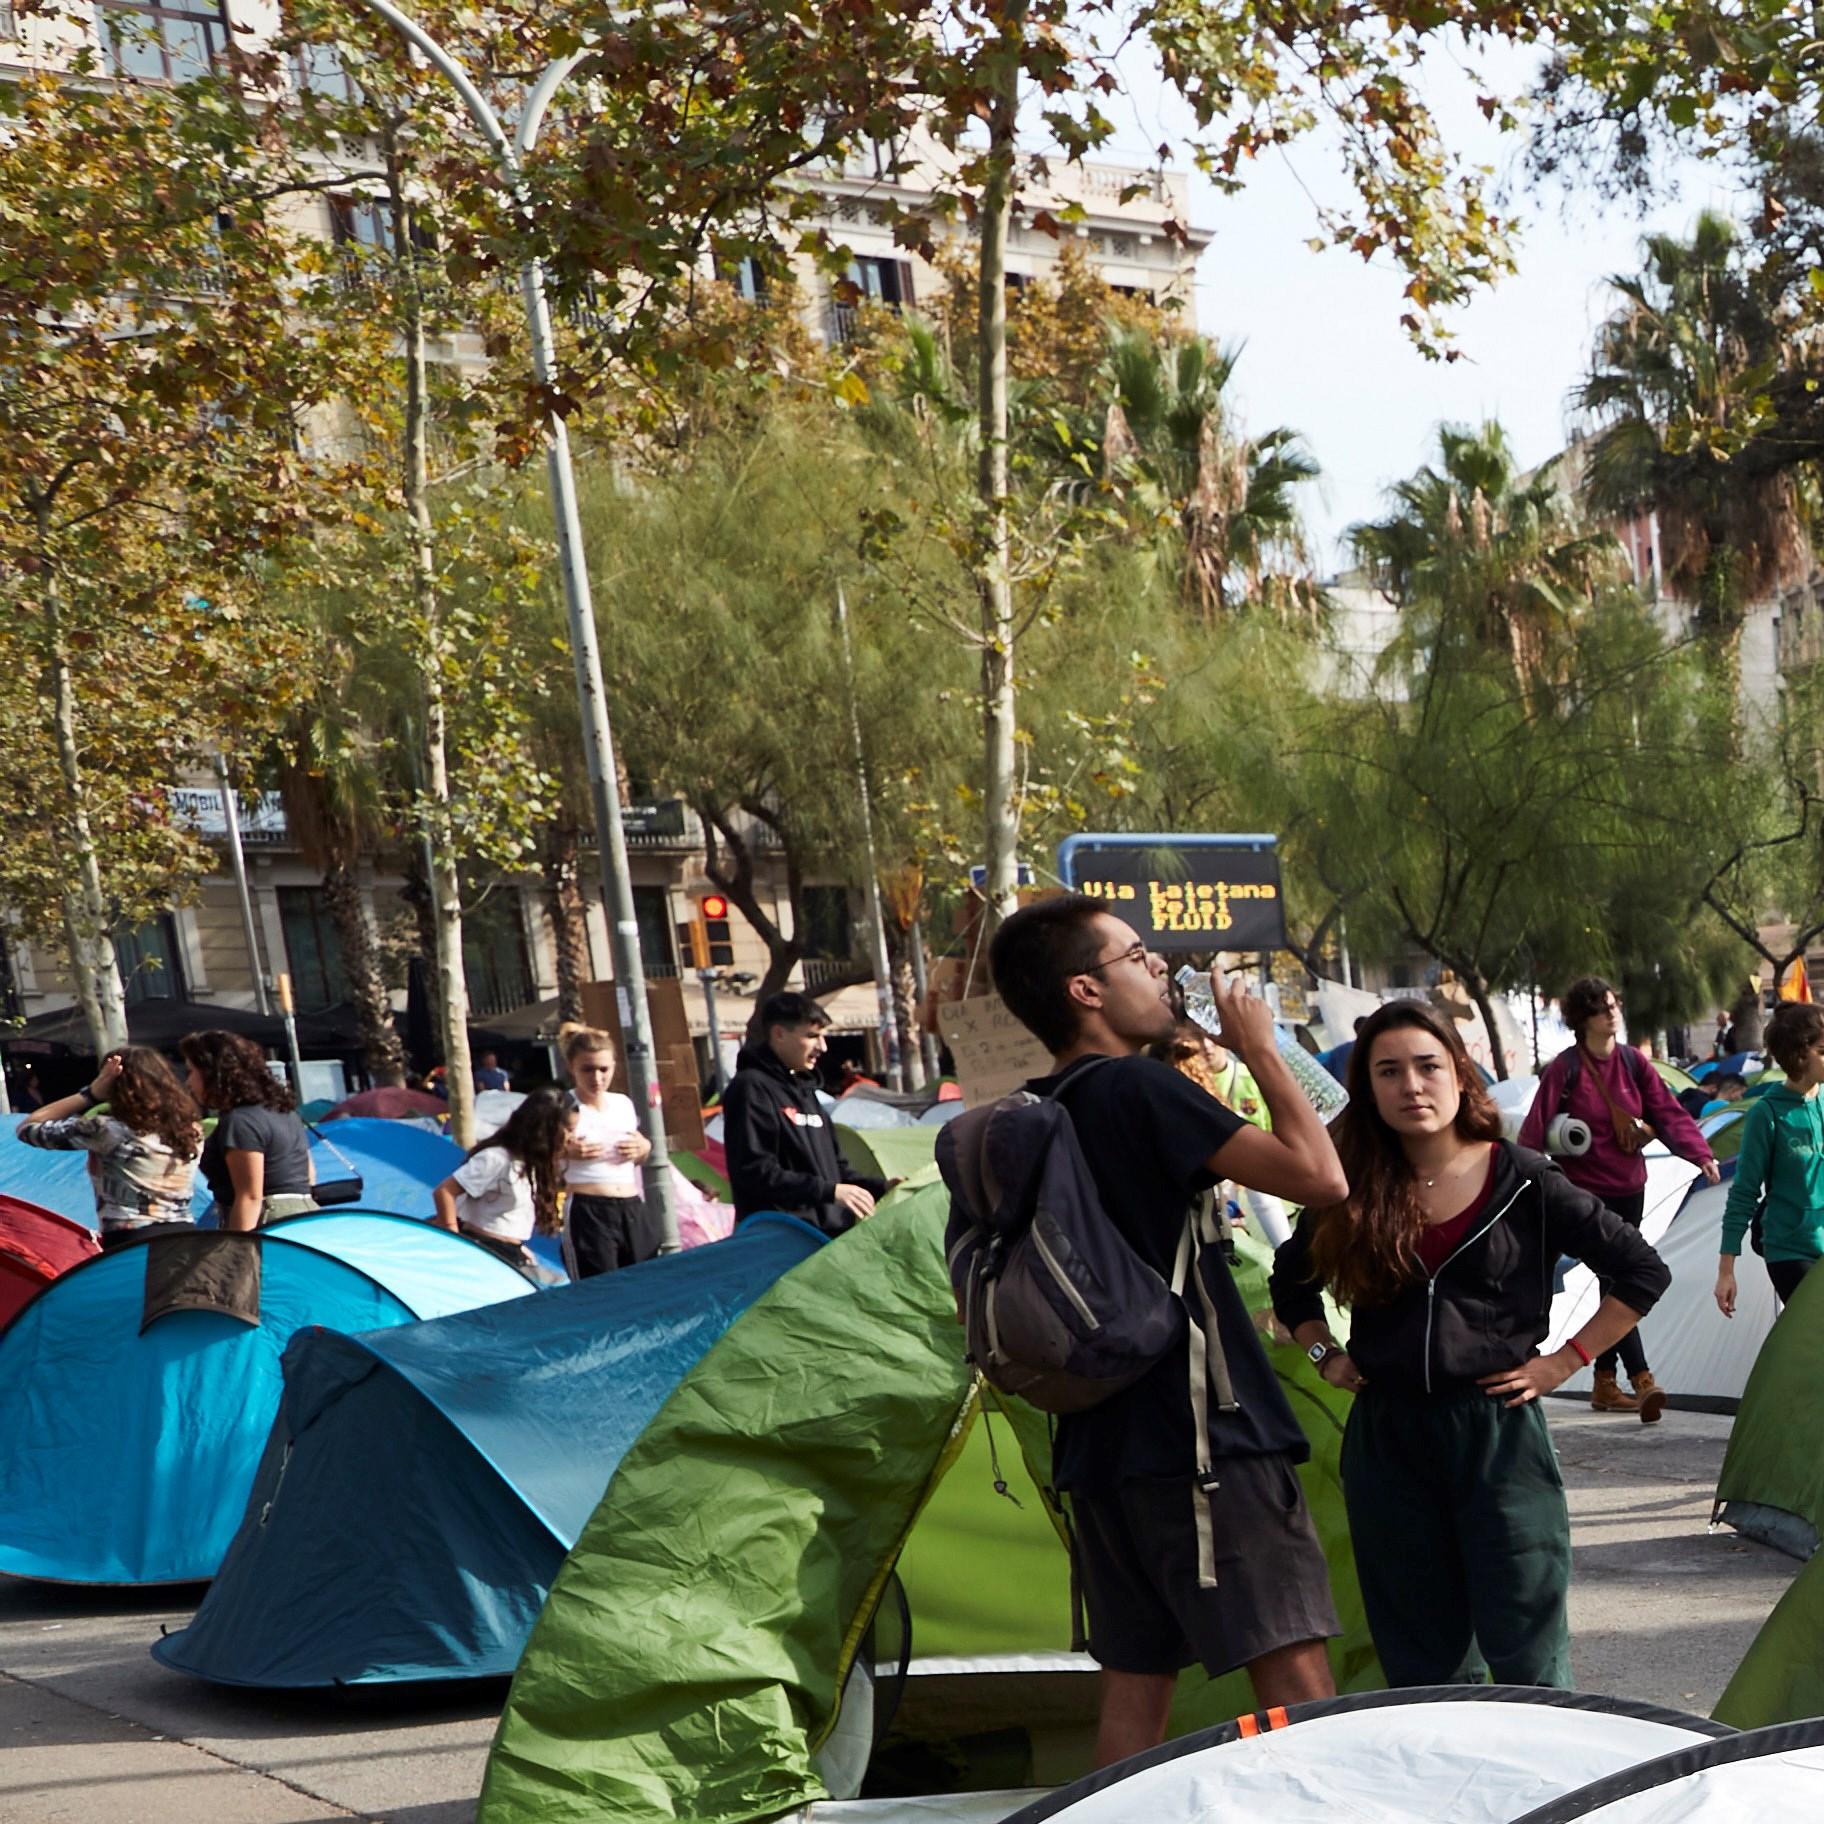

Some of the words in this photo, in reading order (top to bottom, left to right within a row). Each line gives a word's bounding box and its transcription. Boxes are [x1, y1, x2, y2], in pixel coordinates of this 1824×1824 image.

[1083, 880, 1135, 900] Via
[1148, 880, 1276, 899] Laietana
[1151, 899, 1230, 914] Pelai
[1152, 912, 1233, 931] FLUID
